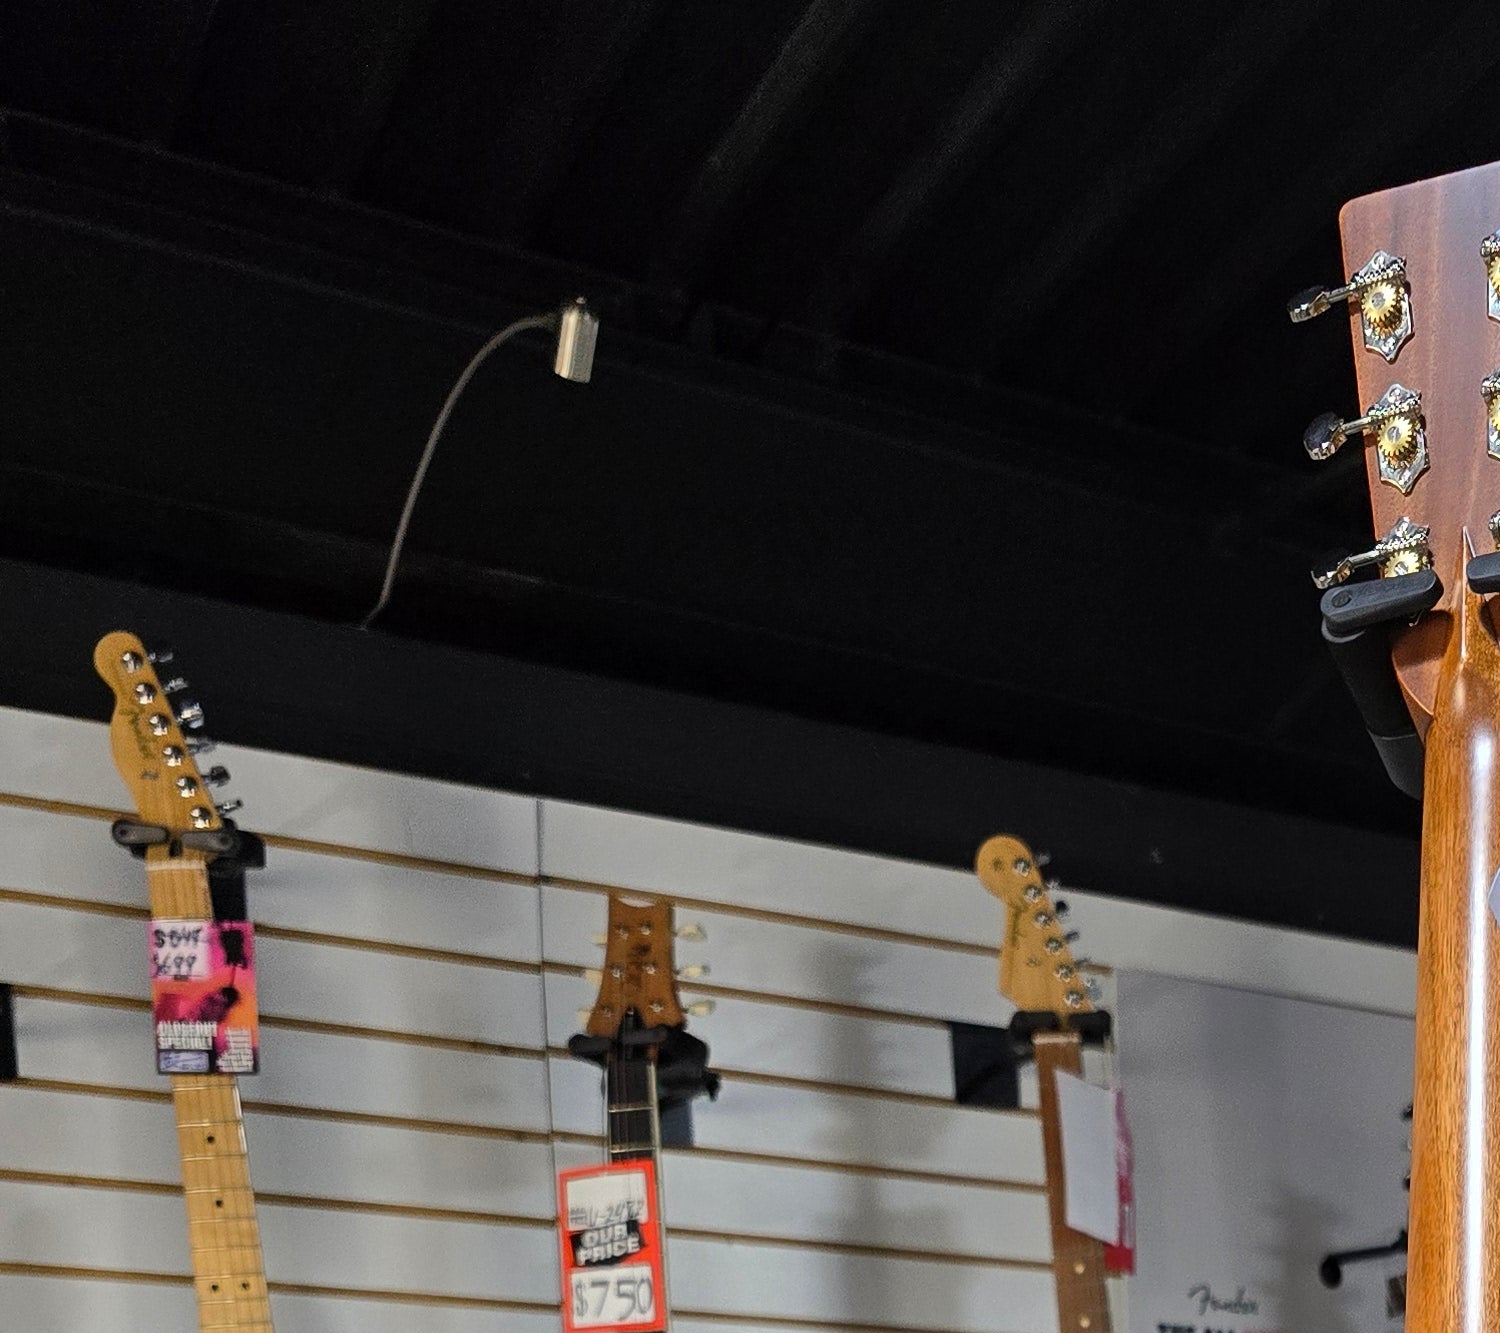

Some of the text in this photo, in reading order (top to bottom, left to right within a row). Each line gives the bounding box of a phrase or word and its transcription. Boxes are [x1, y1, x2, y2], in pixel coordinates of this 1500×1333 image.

[576, 1235, 640, 1267] PRICE
[580, 1222, 628, 1248] OUR
[575, 1277, 654, 1321] $750
[1187, 1284, 1260, 1316] Fender
